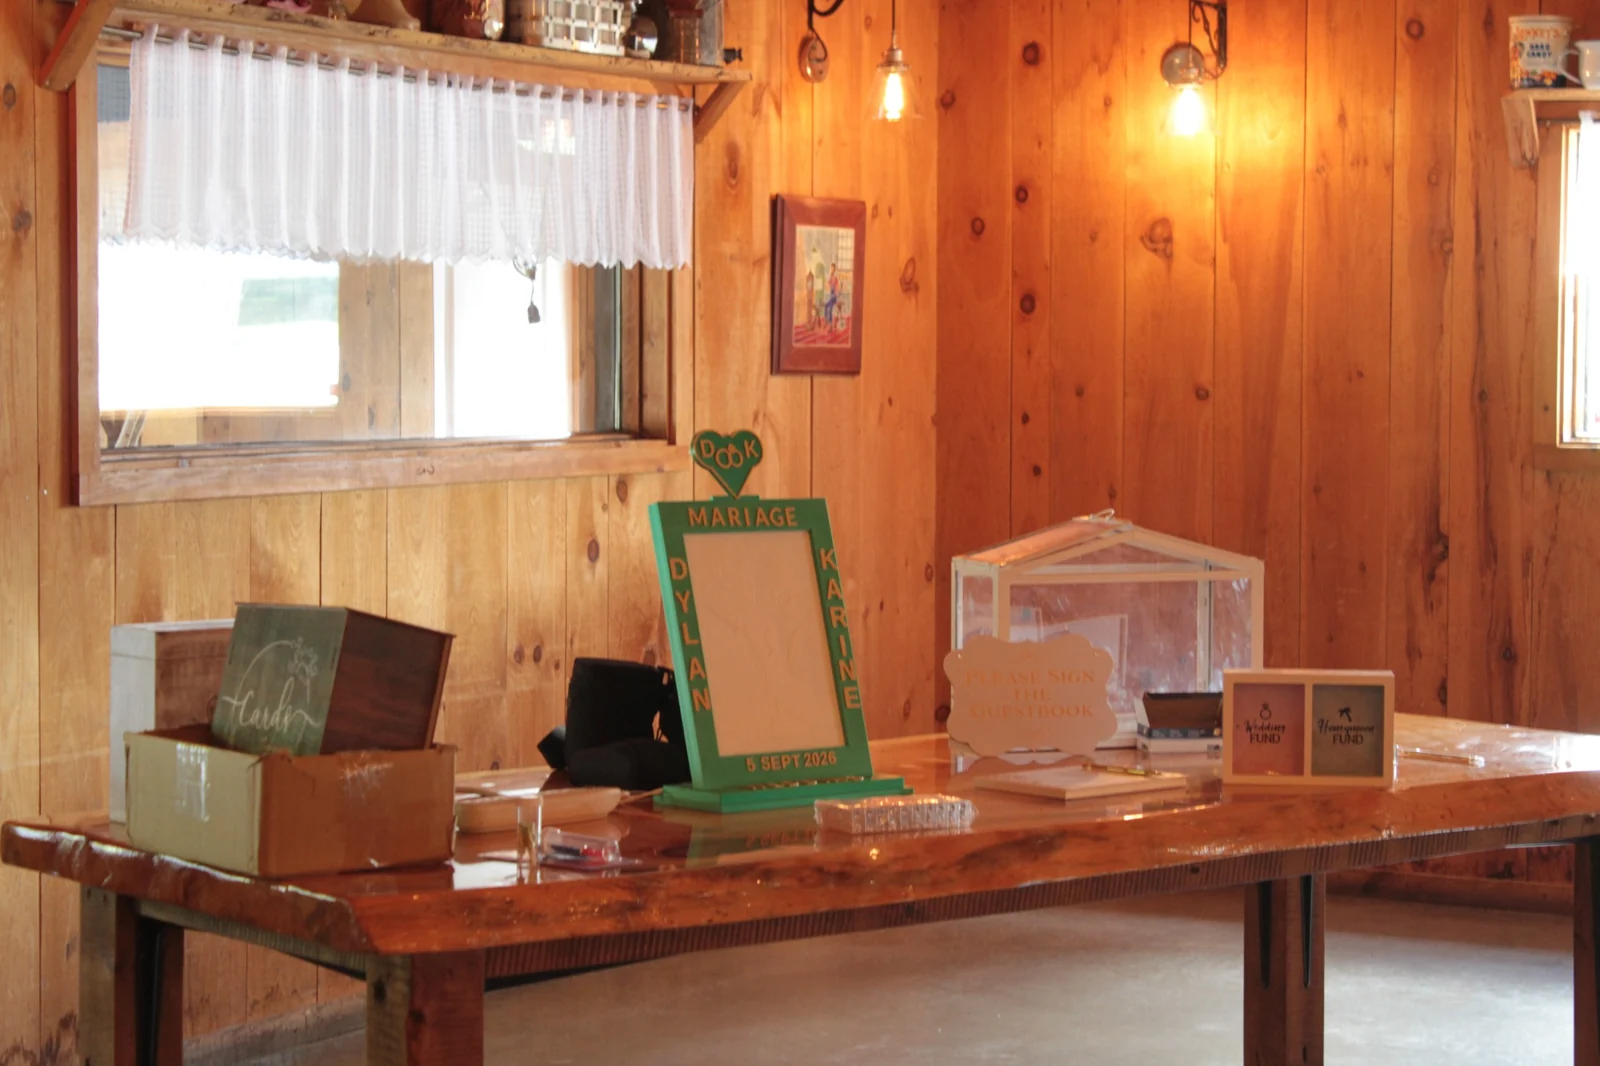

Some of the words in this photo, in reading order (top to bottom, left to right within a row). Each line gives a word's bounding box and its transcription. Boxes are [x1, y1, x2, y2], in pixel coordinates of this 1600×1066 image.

[700, 439, 715, 458] D
[743, 439, 760, 458] K
[687, 506, 798, 528] MARIAGE
[668, 556, 711, 713] DYLAN
[819, 548, 861, 710] KARINE
[965, 669, 1043, 684] PLEASE
[1047, 668, 1096, 684] SIGN
[222, 676, 321, 733] Cards
[1013, 688, 1052, 702] THE
[970, 704, 1095, 720] GUESTBOOK
[1249, 733, 1281, 744] FUND
[1332, 733, 1364, 744] FUND
[745, 756, 757, 773] 5
[761, 754, 801, 771] SEPT
[803, 751, 837, 767] 2026
